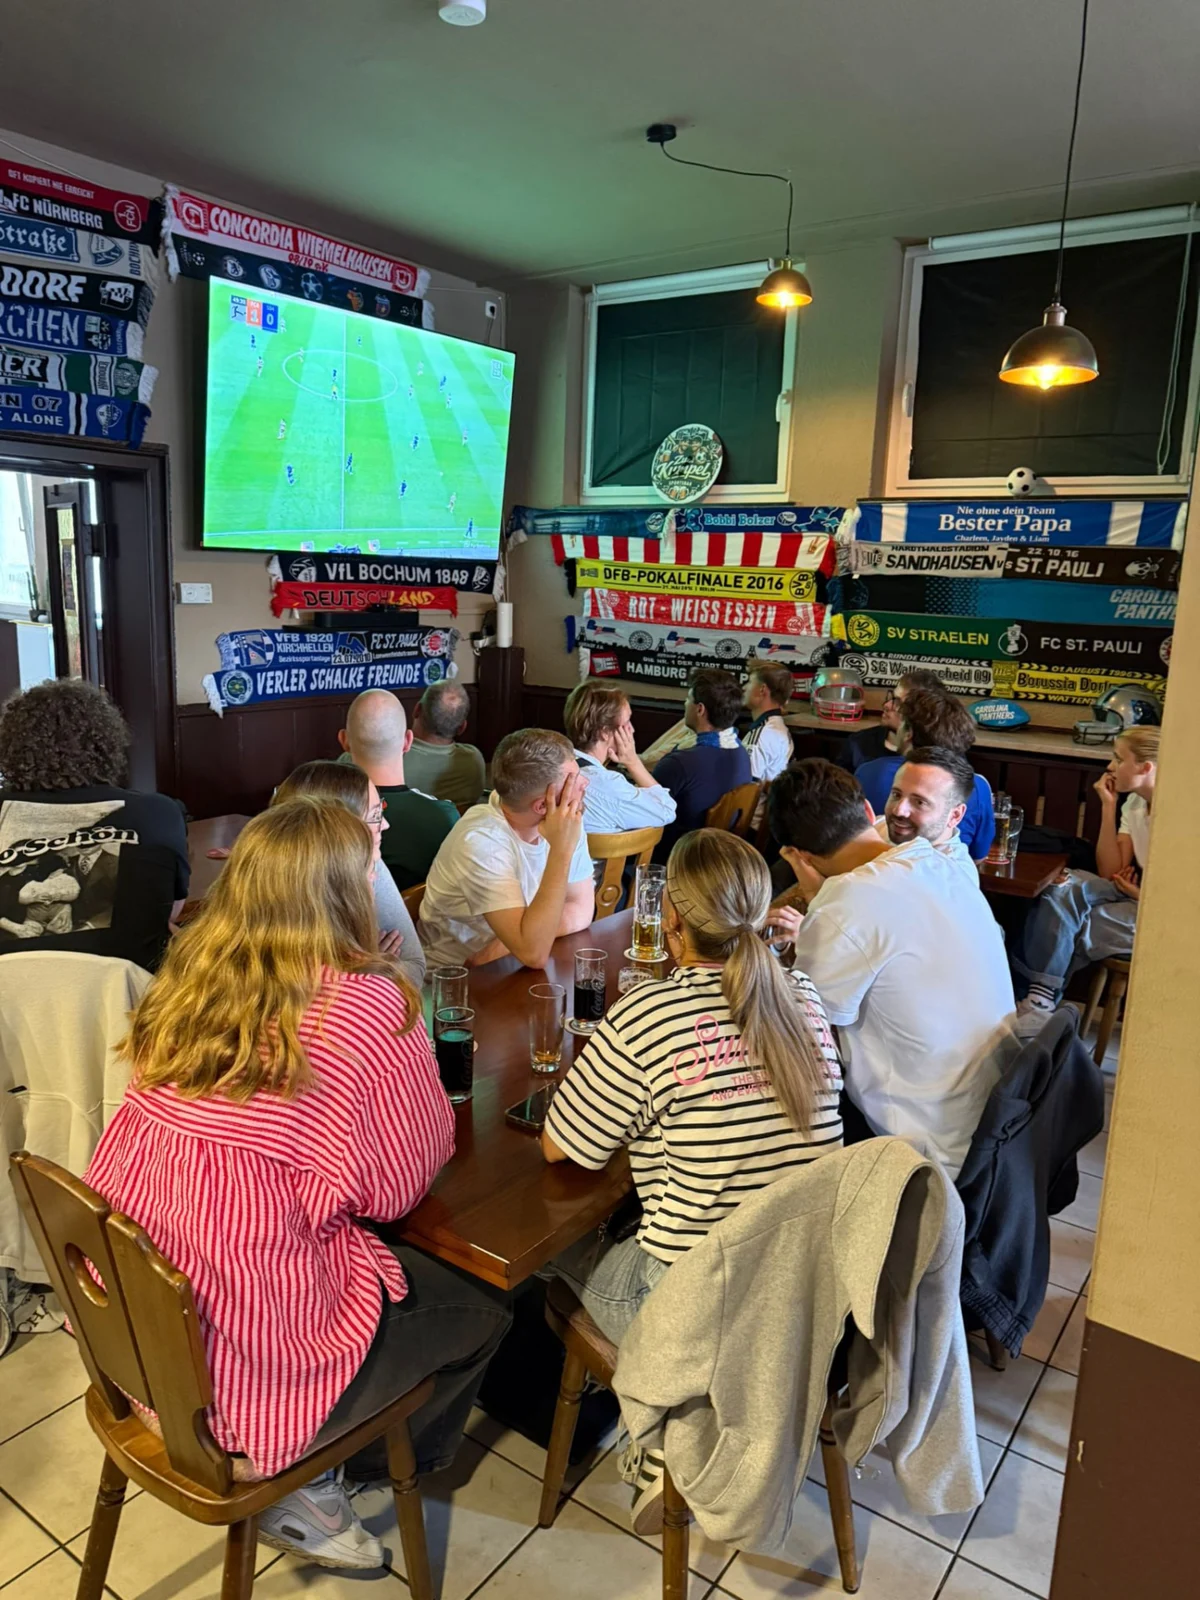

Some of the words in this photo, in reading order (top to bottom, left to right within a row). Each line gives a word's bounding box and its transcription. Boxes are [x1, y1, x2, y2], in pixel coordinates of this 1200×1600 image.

[12, 192, 29, 211] FC
[33, 198, 103, 230] NÜRNBERG
[210, 207, 294, 250] CONCORDIA
[297, 230, 393, 282] WIEMELHAUSEN
[129, 242, 141, 276] BOCHU
[1, 266, 87, 303] DORF
[266, 313, 274, 326] 0
[11, 412, 64, 427] ALONE
[957, 506, 974, 515] Nie
[976, 506, 1000, 515] ohne
[1002, 506, 1024, 515] dein
[1027, 506, 1056, 515] Team
[704, 514, 736, 526] Bobbi
[738, 514, 776, 527] Bolzer
[938, 514, 1008, 531] Bester
[1013, 514, 1072, 537] Papa
[1029, 535, 1050, 543] Liam
[324, 563, 354, 581] VfL
[359, 563, 431, 583] BOCHUM
[435, 569, 469, 585] 1848
[885, 554, 996, 571] SANDHAUSEN
[1045, 558, 1105, 578] PAULI
[603, 567, 743, 590] DFB-POKALFINALE
[745, 576, 784, 591] 2016
[791, 573, 809, 596] BVB
[303, 590, 435, 607] DEUTSCHLAND
[628, 596, 656, 619] ROT
[671, 598, 721, 625] WEISS
[724, 601, 777, 629] ESSEN
[274, 632, 300, 643] VFB
[305, 633, 333, 643] 1920
[370, 633, 383, 650] FC
[887, 626, 906, 640] SV
[909, 628, 990, 646] STRAELEN
[1040, 636, 1061, 651] FC
[1065, 638, 1089, 652] ST.
[1093, 640, 1144, 655] PAULI
[276, 643, 334, 653] KIRCHHELLEN
[871, 660, 888, 674] SG
[888, 653, 918, 661] RUNDE
[920, 655, 970, 666] DFB-POKAL
[256, 669, 307, 696] VERLER
[310, 665, 364, 691] SCHALKE
[367, 663, 421, 687] FREUNDE
[626, 661, 687, 680] HAMBURG
[1017, 673, 1077, 692] Borussia
[975, 704, 1009, 714] CAROLINA
[979, 711, 1015, 721] PANTHERS
[23, 826, 139, 856] schön
[711, 1089, 734, 1102] AND
